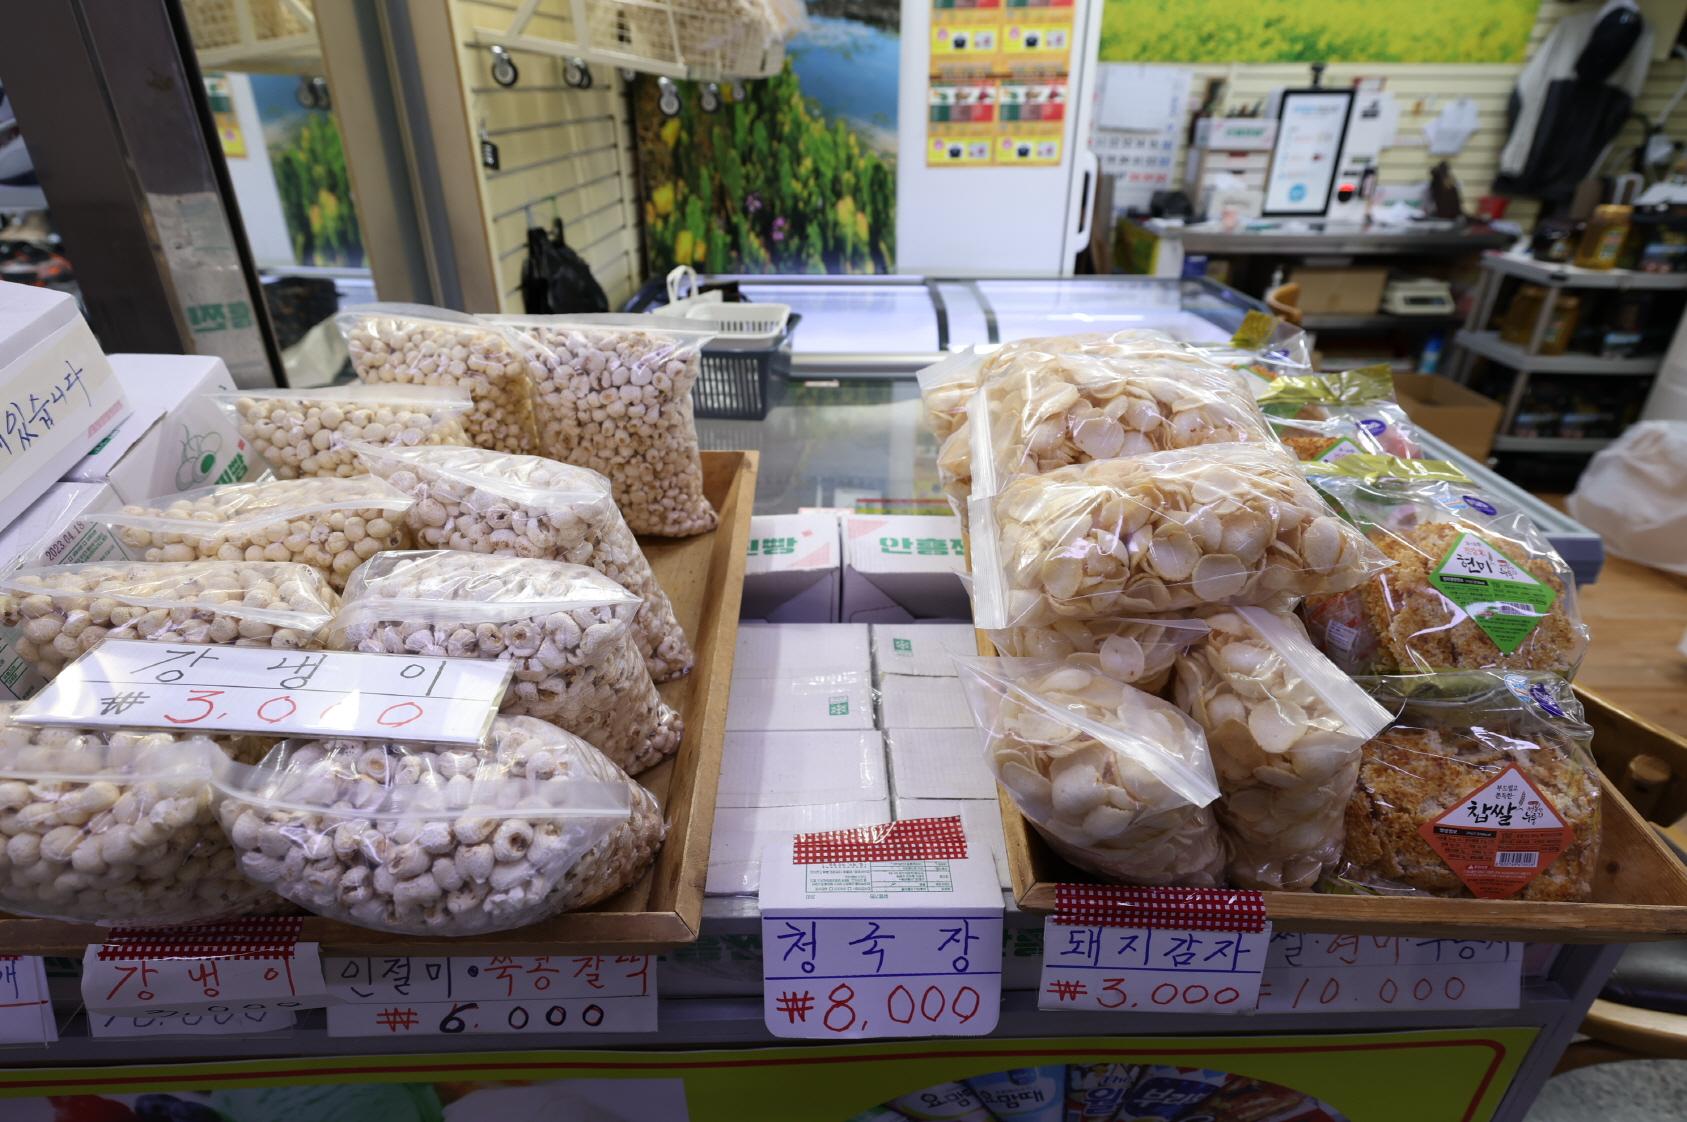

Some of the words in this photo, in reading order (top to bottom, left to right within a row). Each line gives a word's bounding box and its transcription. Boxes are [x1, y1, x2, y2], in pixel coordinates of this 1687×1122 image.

[0, 360, 92, 455] 있습니다
[1456, 553, 1493, 574] 현미
[131, 648, 447, 697] 강냉이
[101, 689, 423, 729] ₩3,00
[1467, 800, 1518, 826] 찹쌀
[777, 918, 980, 974] 청국장
[1060, 927, 1251, 971] 돼지감자
[106, 960, 297, 1001] 강냉이
